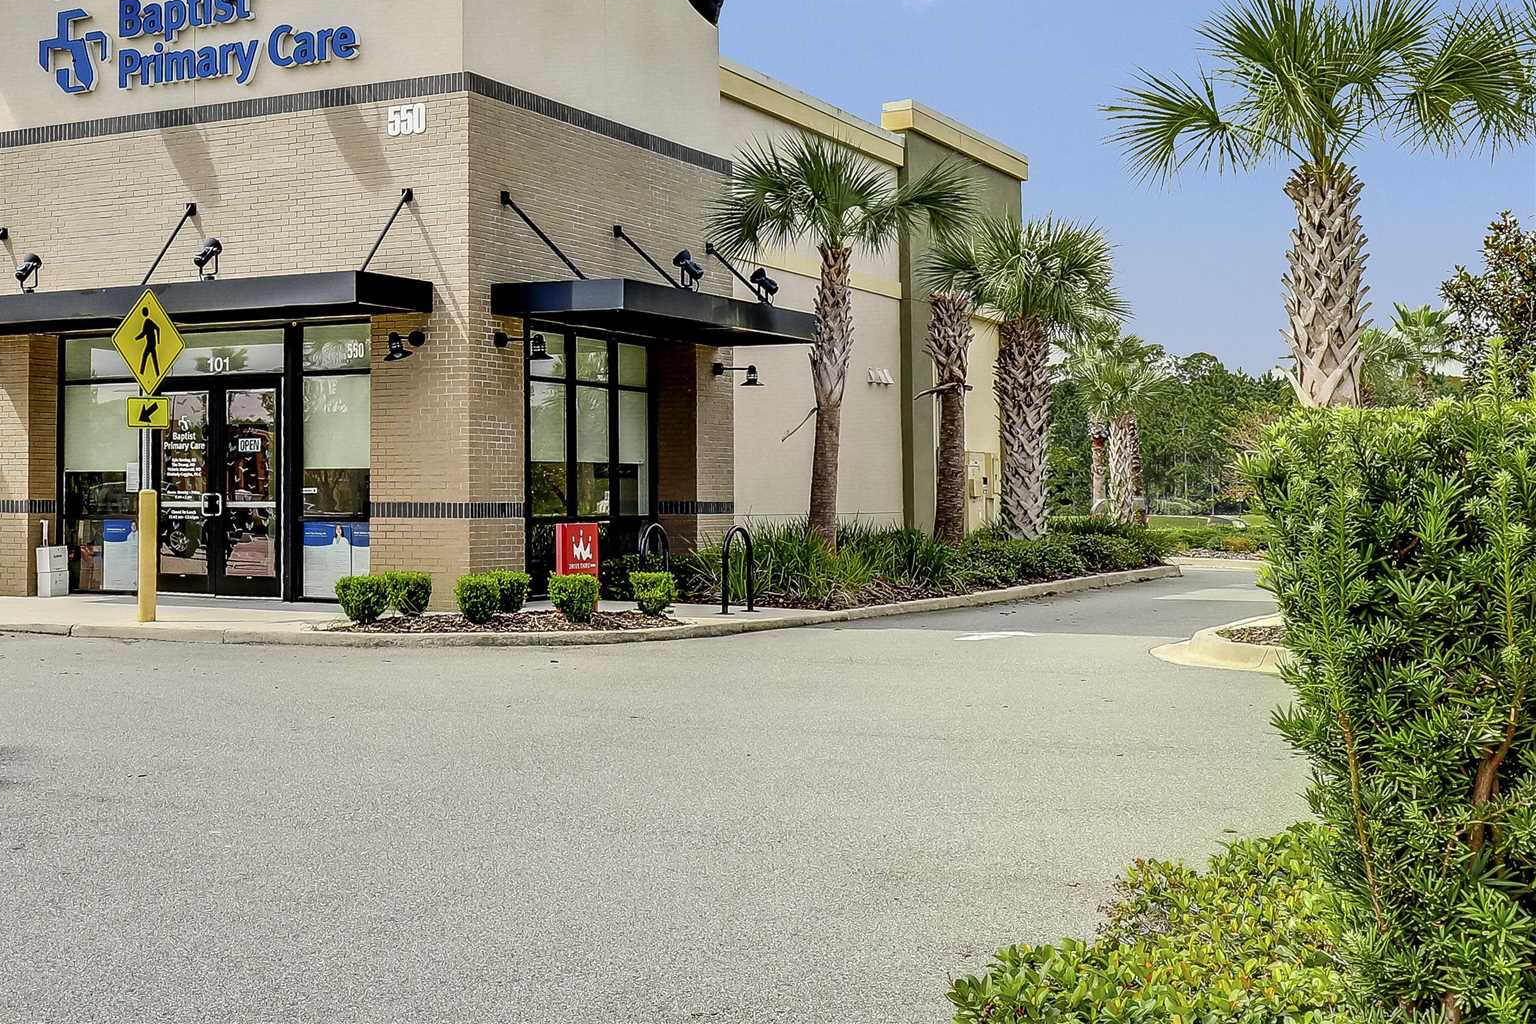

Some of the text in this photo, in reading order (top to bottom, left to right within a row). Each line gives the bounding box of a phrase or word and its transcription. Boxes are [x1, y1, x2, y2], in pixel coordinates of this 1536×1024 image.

[118, 24, 359, 88] Primary Care
[387, 103, 426, 136] 550
[347, 342, 364, 359] 550
[207, 356, 231, 372] 101
[172, 431, 196, 442] Baptist
[163, 440, 206, 452] Primary Care
[240, 439, 260, 451] OPEN
